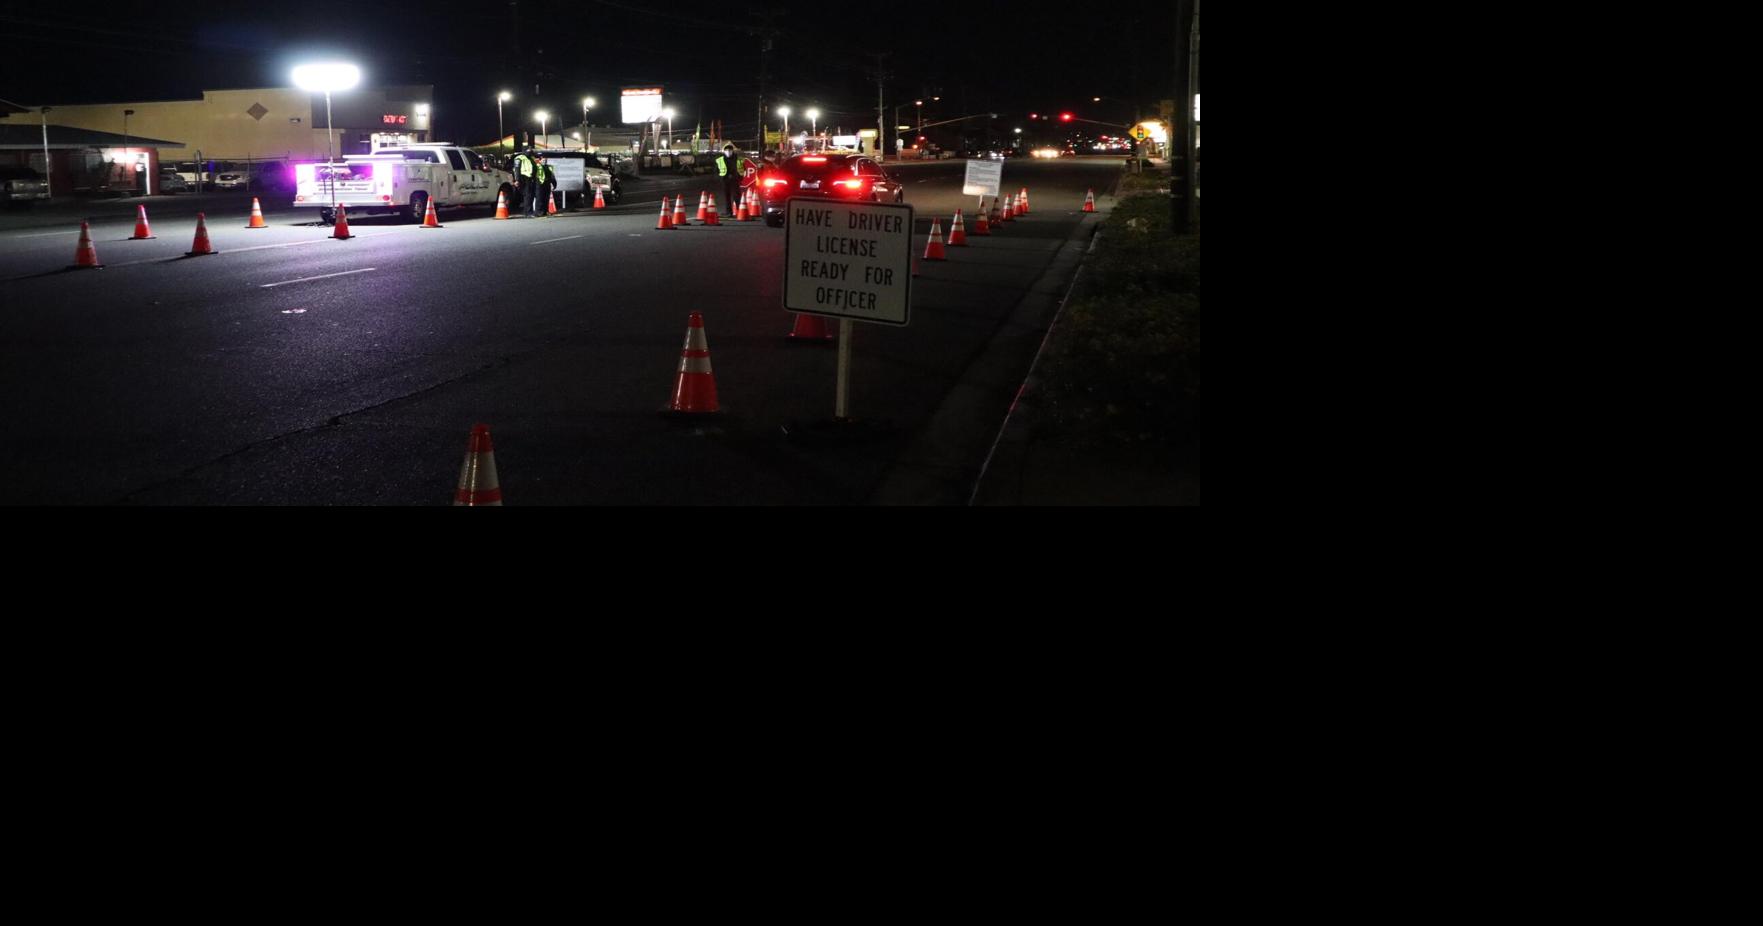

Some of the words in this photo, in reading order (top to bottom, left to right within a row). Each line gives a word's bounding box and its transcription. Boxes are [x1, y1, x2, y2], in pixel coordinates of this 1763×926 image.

[796, 208, 832, 227] HAVE
[848, 211, 903, 233] DRIVER
[817, 236, 878, 258] LICENSE
[801, 260, 849, 281] READY
[865, 266, 894, 286] FOR
[816, 287, 877, 310] OFFICER
